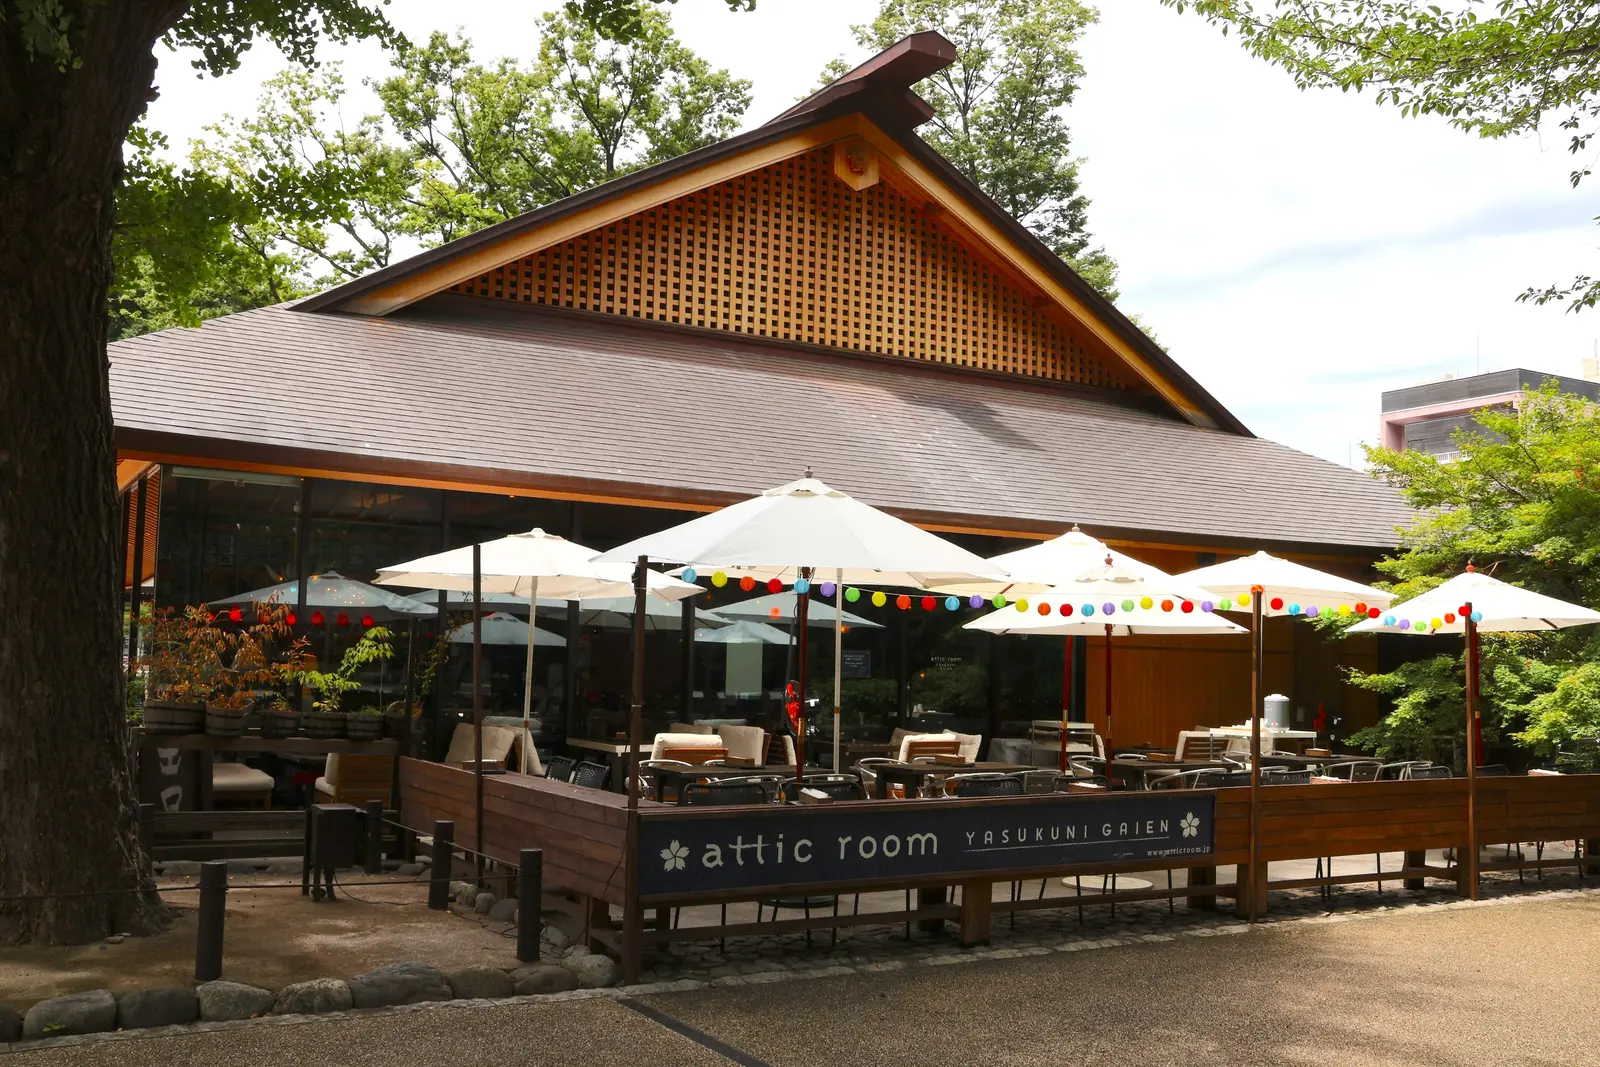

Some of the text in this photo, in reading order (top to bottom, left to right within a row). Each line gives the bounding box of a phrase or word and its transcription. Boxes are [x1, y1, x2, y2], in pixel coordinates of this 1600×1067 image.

[966, 819, 1169, 845] YASUKUNI GAIEN
[702, 832, 938, 868] attic room
